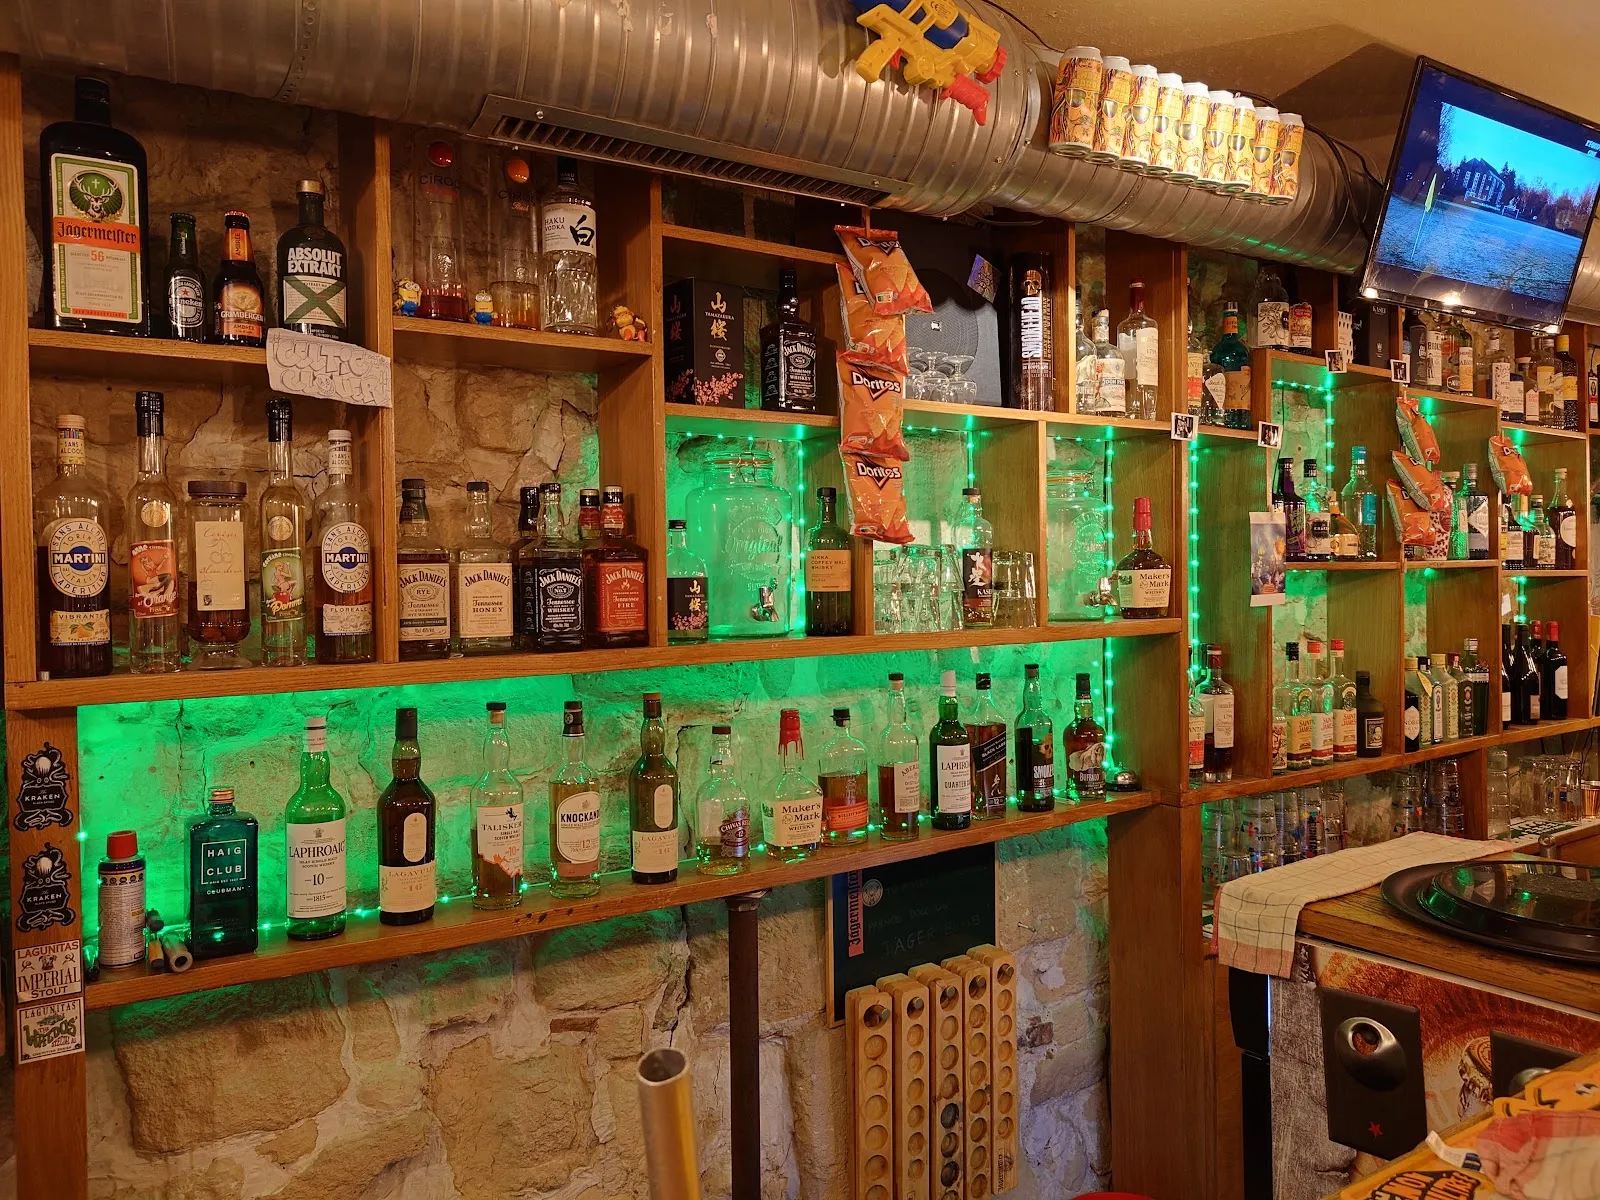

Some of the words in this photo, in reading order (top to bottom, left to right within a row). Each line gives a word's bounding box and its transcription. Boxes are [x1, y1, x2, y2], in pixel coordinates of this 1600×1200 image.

[544, 217, 566, 226] HAKU
[544, 224, 566, 232] VODKA
[57, 222, 137, 245] Jägermeister
[569, 214, 595, 247] 白
[91, 250, 105, 262] 56
[287, 247, 343, 266] ABSOLUT
[287, 260, 342, 278] EXTRAKT
[711, 291, 727, 313] 山
[220, 310, 264, 322] GRIMBERGEN
[705, 311, 735, 321] YAMAZAKURA
[1020, 296, 1042, 359] SMOKEHEAD
[783, 343, 797, 356] JACK
[852, 371, 901, 393] Doritos
[857, 462, 902, 480] Doritos
[53, 525, 72, 547] SANS
[78, 522, 105, 546] ALCOOL
[63, 533, 98, 546] TORINO
[324, 529, 342, 547] SANS
[346, 526, 369, 549] ALCOOL
[333, 535, 362, 547] TORINO
[53, 553, 106, 564] MARTINI
[326, 553, 369, 563] MARTINI
[53, 570, 106, 595] L'APERITIVO
[325, 569, 369, 590] L'APERITIVO
[399, 573, 418, 588] JACK
[418, 570, 447, 588] DANIEL'S
[464, 573, 483, 587] JACK
[483, 569, 510, 587] DANIEL'S
[539, 573, 556, 588] JACK
[556, 570, 582, 588] DANIEL'S
[605, 571, 621, 585] JACK
[621, 567, 645, 584] DANIEL'S
[1139, 573, 1170, 581] Maker's
[688, 580, 702, 595] 山
[546, 598, 576, 606] Tennessee
[24, 793, 61, 802] KRAKEN
[781, 802, 821, 814] Maker's
[794, 812, 820, 823] Mark
[481, 821, 522, 831] TALISKER
[720, 822, 741, 832] CHIVAS
[788, 824, 815, 832] WHISKY
[289, 840, 345, 859] LAPHROAIG
[508, 846, 516, 856] 10
[582, 840, 591, 849] 12
[207, 847, 242, 858] HAIG
[206, 865, 242, 876] CLUB
[312, 873, 325, 886] 10
[206, 887, 242, 895] CLUBMAN
[409, 883, 422, 892] 16
[26, 893, 62, 902] KRAKEN
[17, 942, 79, 960] LAGUNITAS
[18, 966, 80, 993] IMPERIAL
[31, 986, 68, 999] STOUT
[24, 1001, 76, 1020] LAGUNITAS
